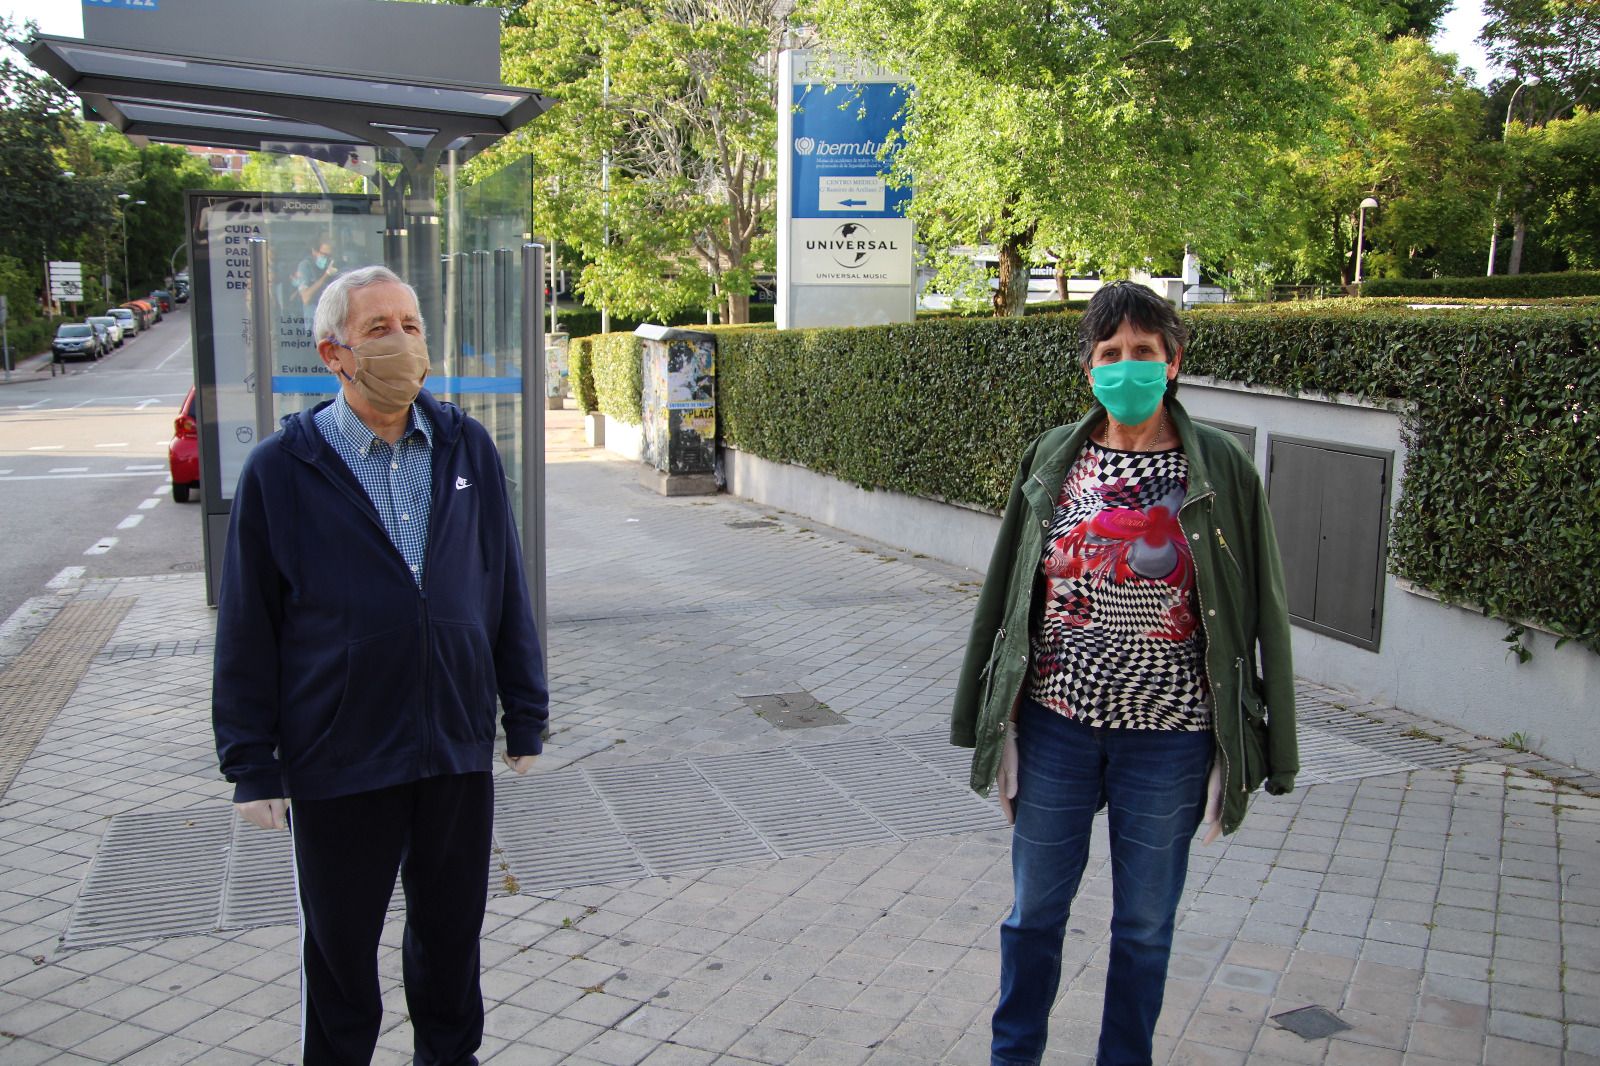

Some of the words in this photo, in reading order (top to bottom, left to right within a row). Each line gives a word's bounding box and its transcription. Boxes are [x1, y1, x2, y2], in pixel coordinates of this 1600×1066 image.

[225, 225, 260, 233] CUIDA
[225, 237, 240, 245] DE
[243, 237, 251, 245] T
[806, 240, 898, 250] UNIVERSAL
[225, 248, 249, 256] PAR
[238, 271, 252, 279] LO
[281, 328, 293, 336] La
[281, 339, 311, 349] mejor
[282, 364, 308, 373] Evita
